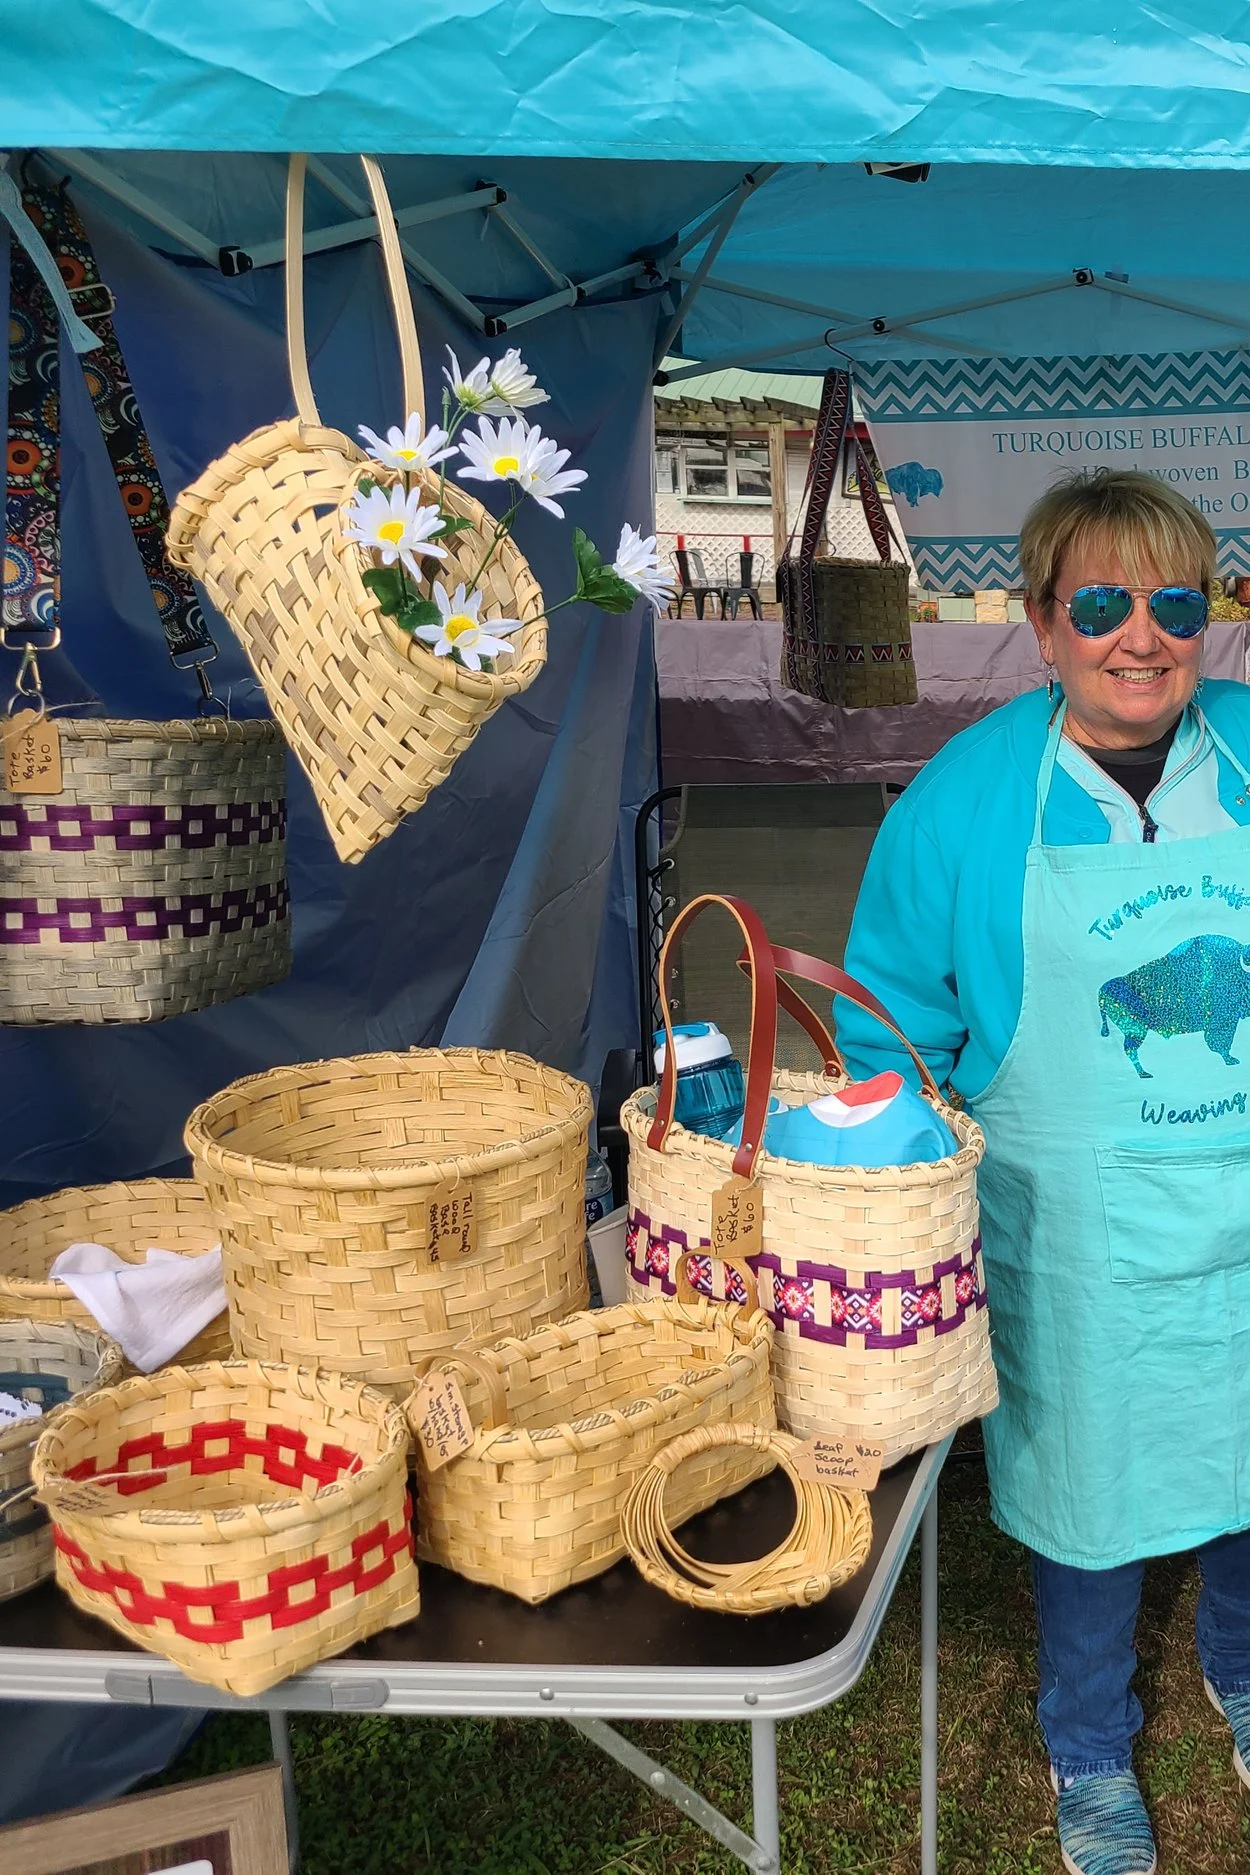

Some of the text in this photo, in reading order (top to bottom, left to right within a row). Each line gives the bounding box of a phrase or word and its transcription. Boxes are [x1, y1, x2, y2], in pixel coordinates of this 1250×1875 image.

[992, 429, 1144, 456] TURQUOISE
[9, 752, 21, 787] Tote
[37, 744, 52, 774] $60
[1088, 884, 1192, 940] Turquoise
[1141, 1091, 1247, 1125] Weaving
[462, 1192, 474, 1220] Tall
[741, 1202, 755, 1234] $60
[713, 1215, 728, 1255] Tote
